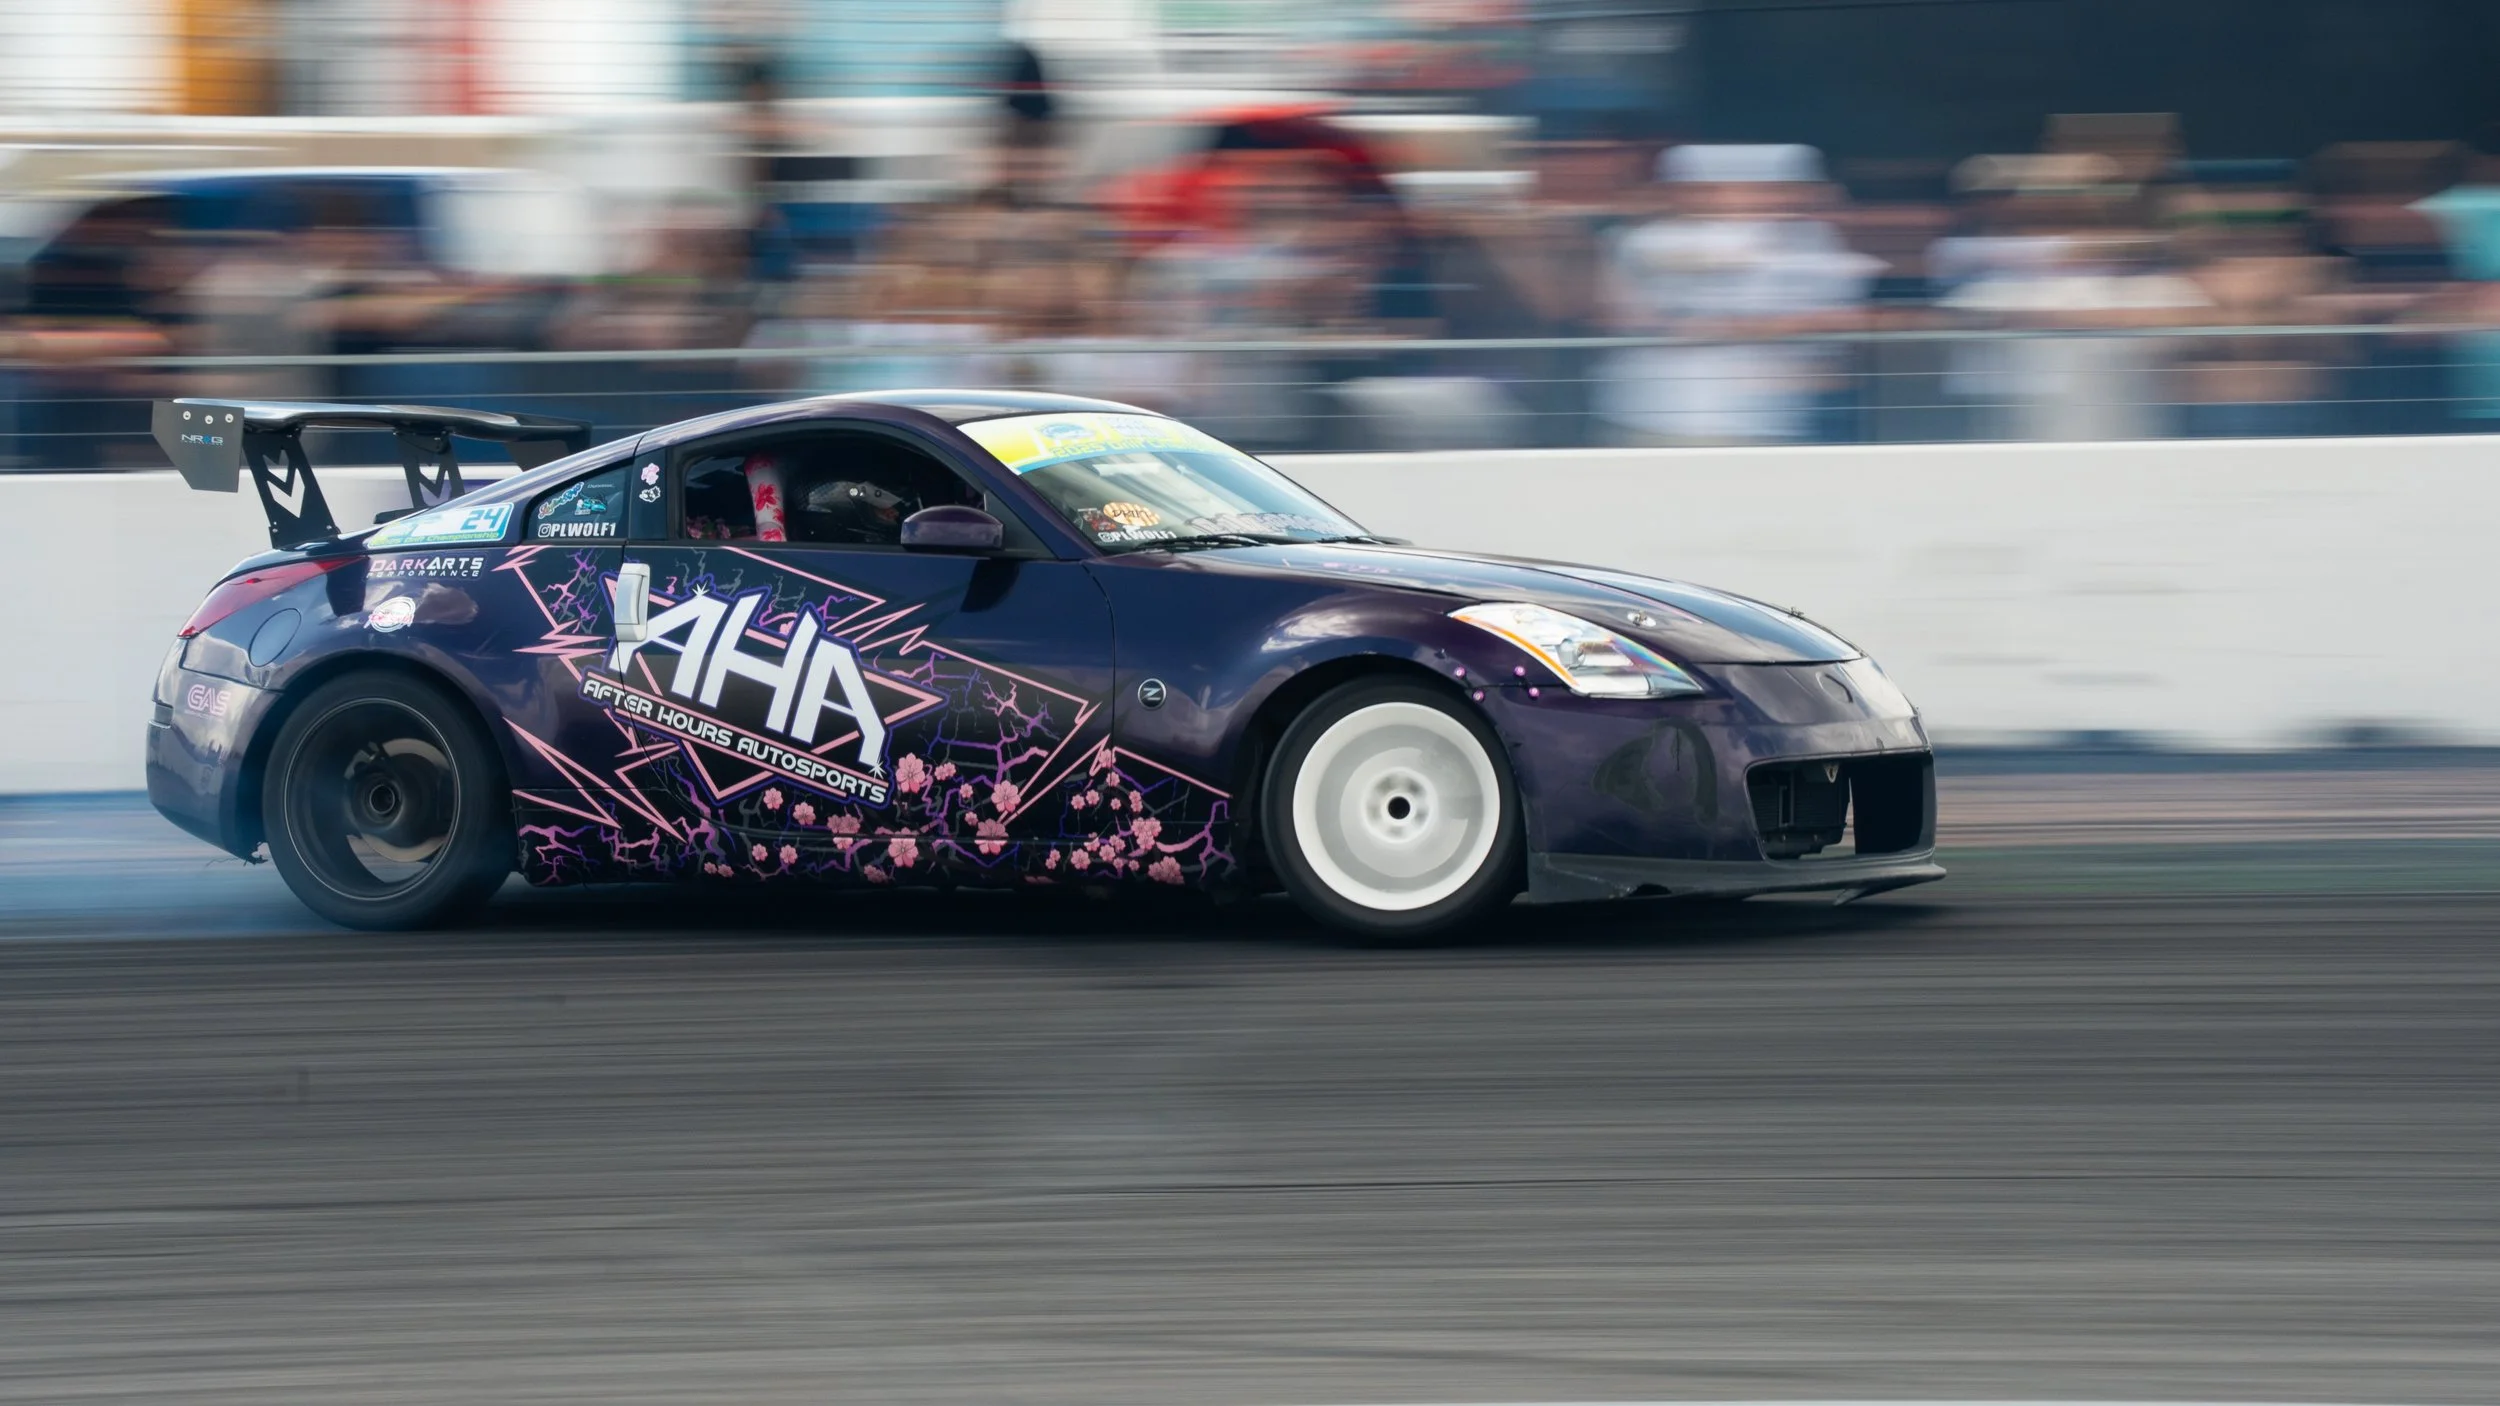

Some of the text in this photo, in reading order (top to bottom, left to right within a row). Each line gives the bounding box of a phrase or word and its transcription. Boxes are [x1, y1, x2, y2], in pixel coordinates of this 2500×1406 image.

[460, 507, 505, 531] 24
[427, 531, 500, 542] Championship
[366, 569, 480, 579] PERFORMANCE
[369, 556, 485, 573] DARKARTS
[608, 588, 886, 770] AHA
[187, 683, 231, 717] GAS
[582, 678, 888, 804] AFTER HOURS AUTOSPORTS
